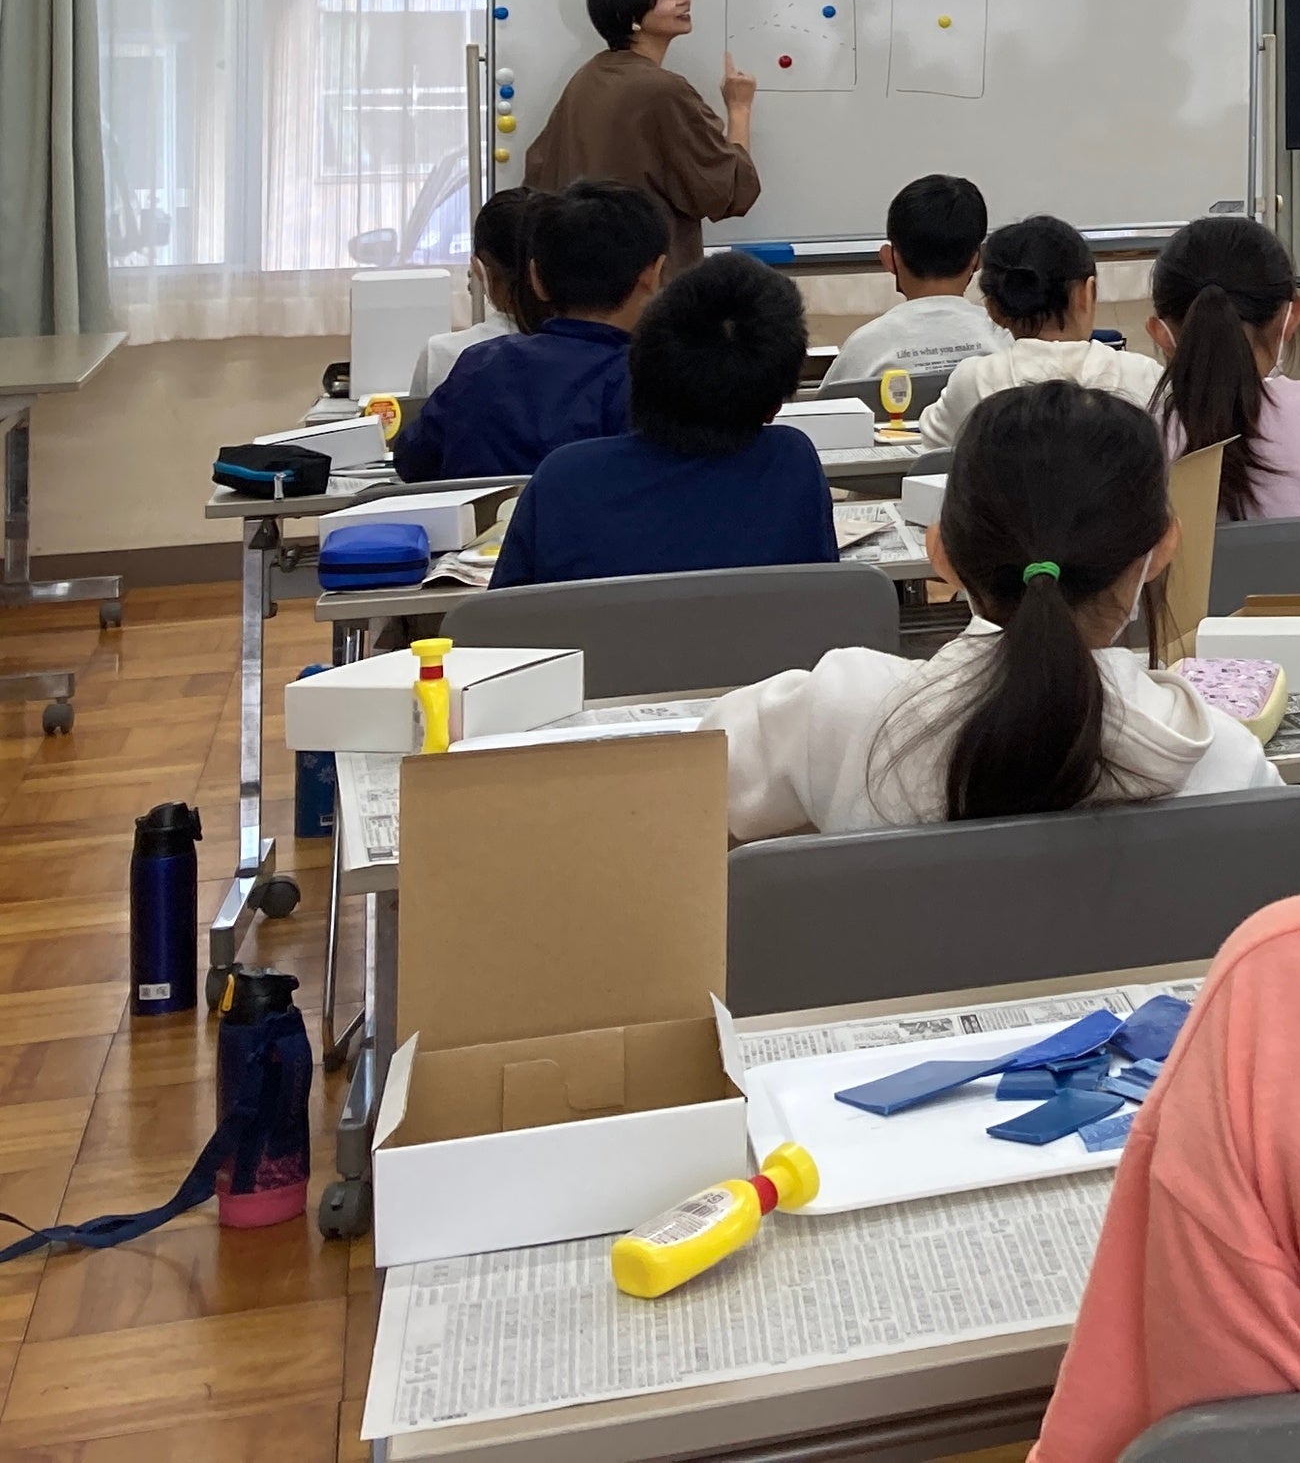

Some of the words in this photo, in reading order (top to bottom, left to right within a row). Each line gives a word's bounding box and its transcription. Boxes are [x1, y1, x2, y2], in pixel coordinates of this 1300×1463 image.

[896, 349, 911, 359] Life
[912, 349, 919, 357] is
[920, 347, 938, 356] what
[940, 346, 953, 356] you
[955, 343, 974, 352] make
